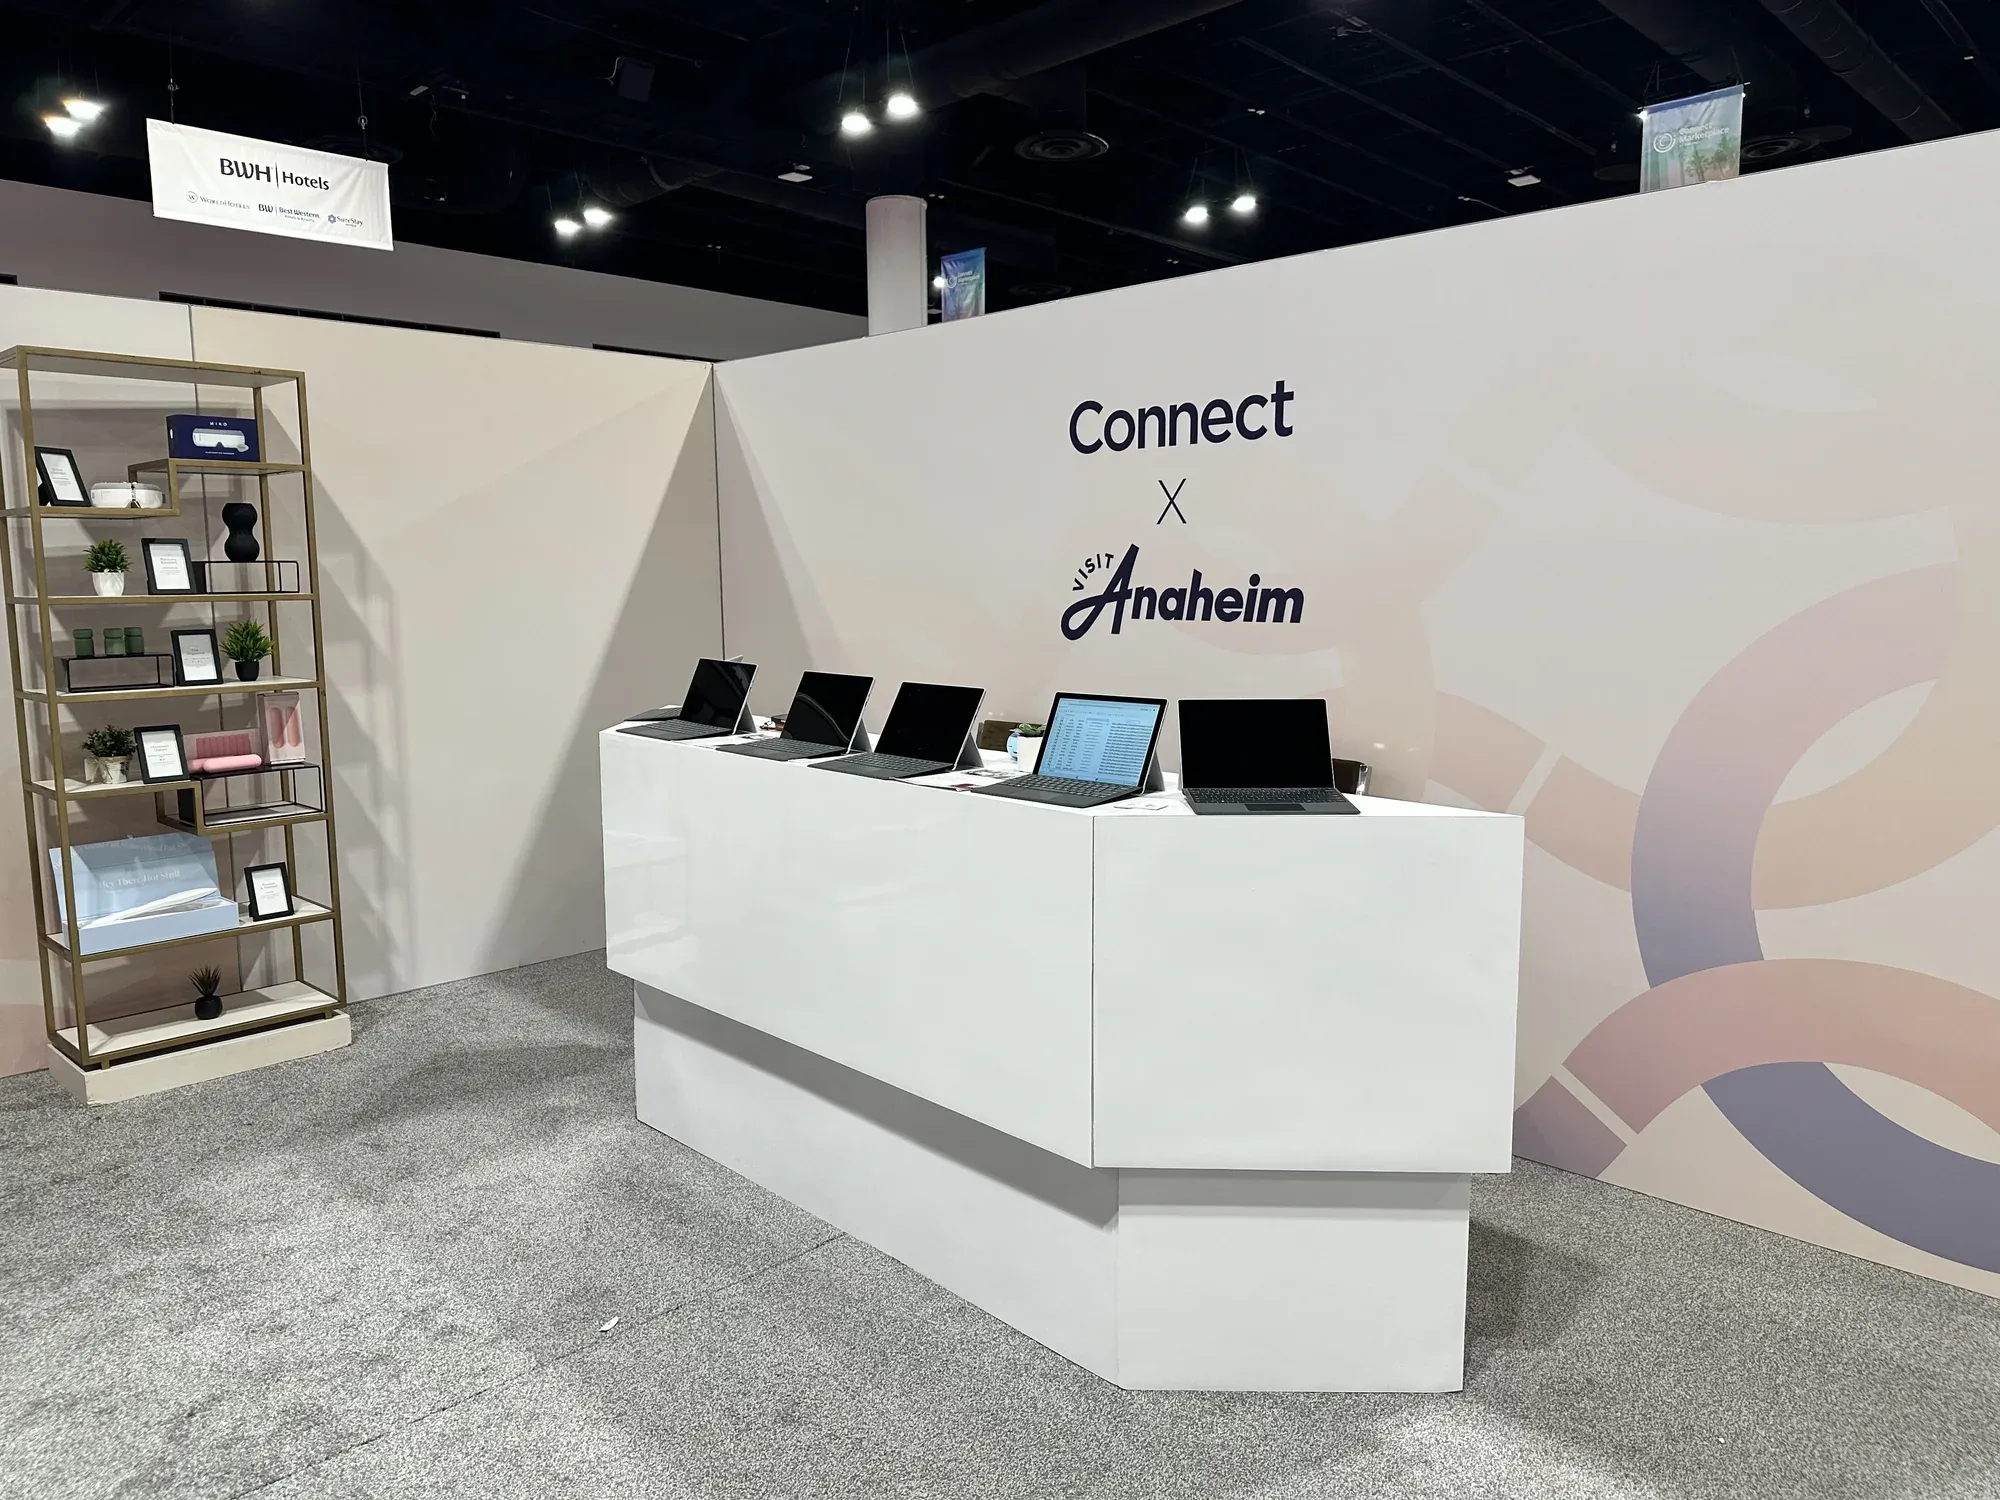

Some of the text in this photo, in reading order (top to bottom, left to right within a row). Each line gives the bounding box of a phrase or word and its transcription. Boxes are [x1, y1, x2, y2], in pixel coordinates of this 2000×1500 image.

[1679, 122, 1712, 135] Connect
[1679, 127, 1730, 143] Marketplace
[220, 158, 330, 190] BWH Hotels
[258, 204, 274, 213] BW
[293, 209, 320, 219] Western
[337, 216, 363, 226] SureStay
[1069, 380, 1294, 454] Connect
[1072, 553, 1114, 591] VISIT
[1061, 543, 1304, 641] Anaheim
